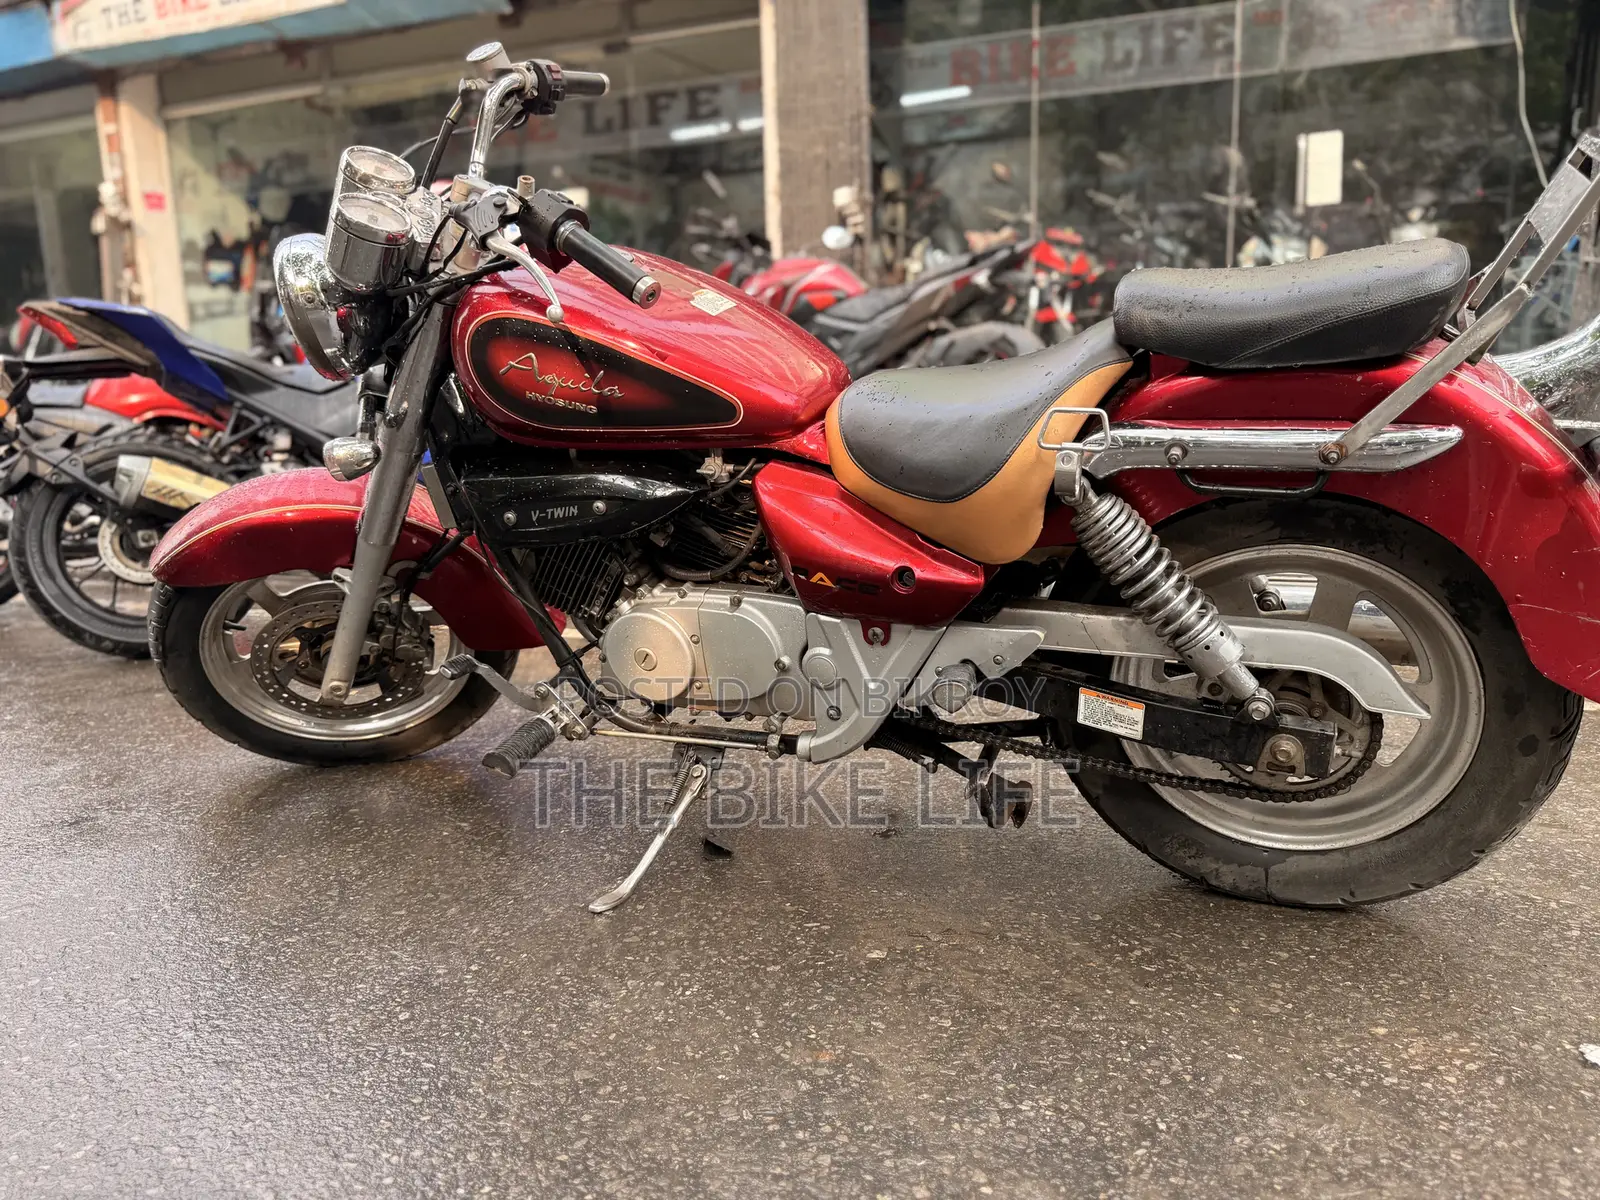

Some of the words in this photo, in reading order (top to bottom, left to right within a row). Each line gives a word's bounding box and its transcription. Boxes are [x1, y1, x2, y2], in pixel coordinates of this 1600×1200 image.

[101, 0, 147, 29] THE
[951, 35, 1077, 86] BIKE
[1102, 14, 1238, 71] LIFE
[581, 85, 722, 135] LIFE
[500, 352, 625, 398] Aquila
[526, 390, 598, 414] HYOSUNG
[531, 505, 578, 525] V-TWIN
[1101, 694, 1129, 706] WARNING
